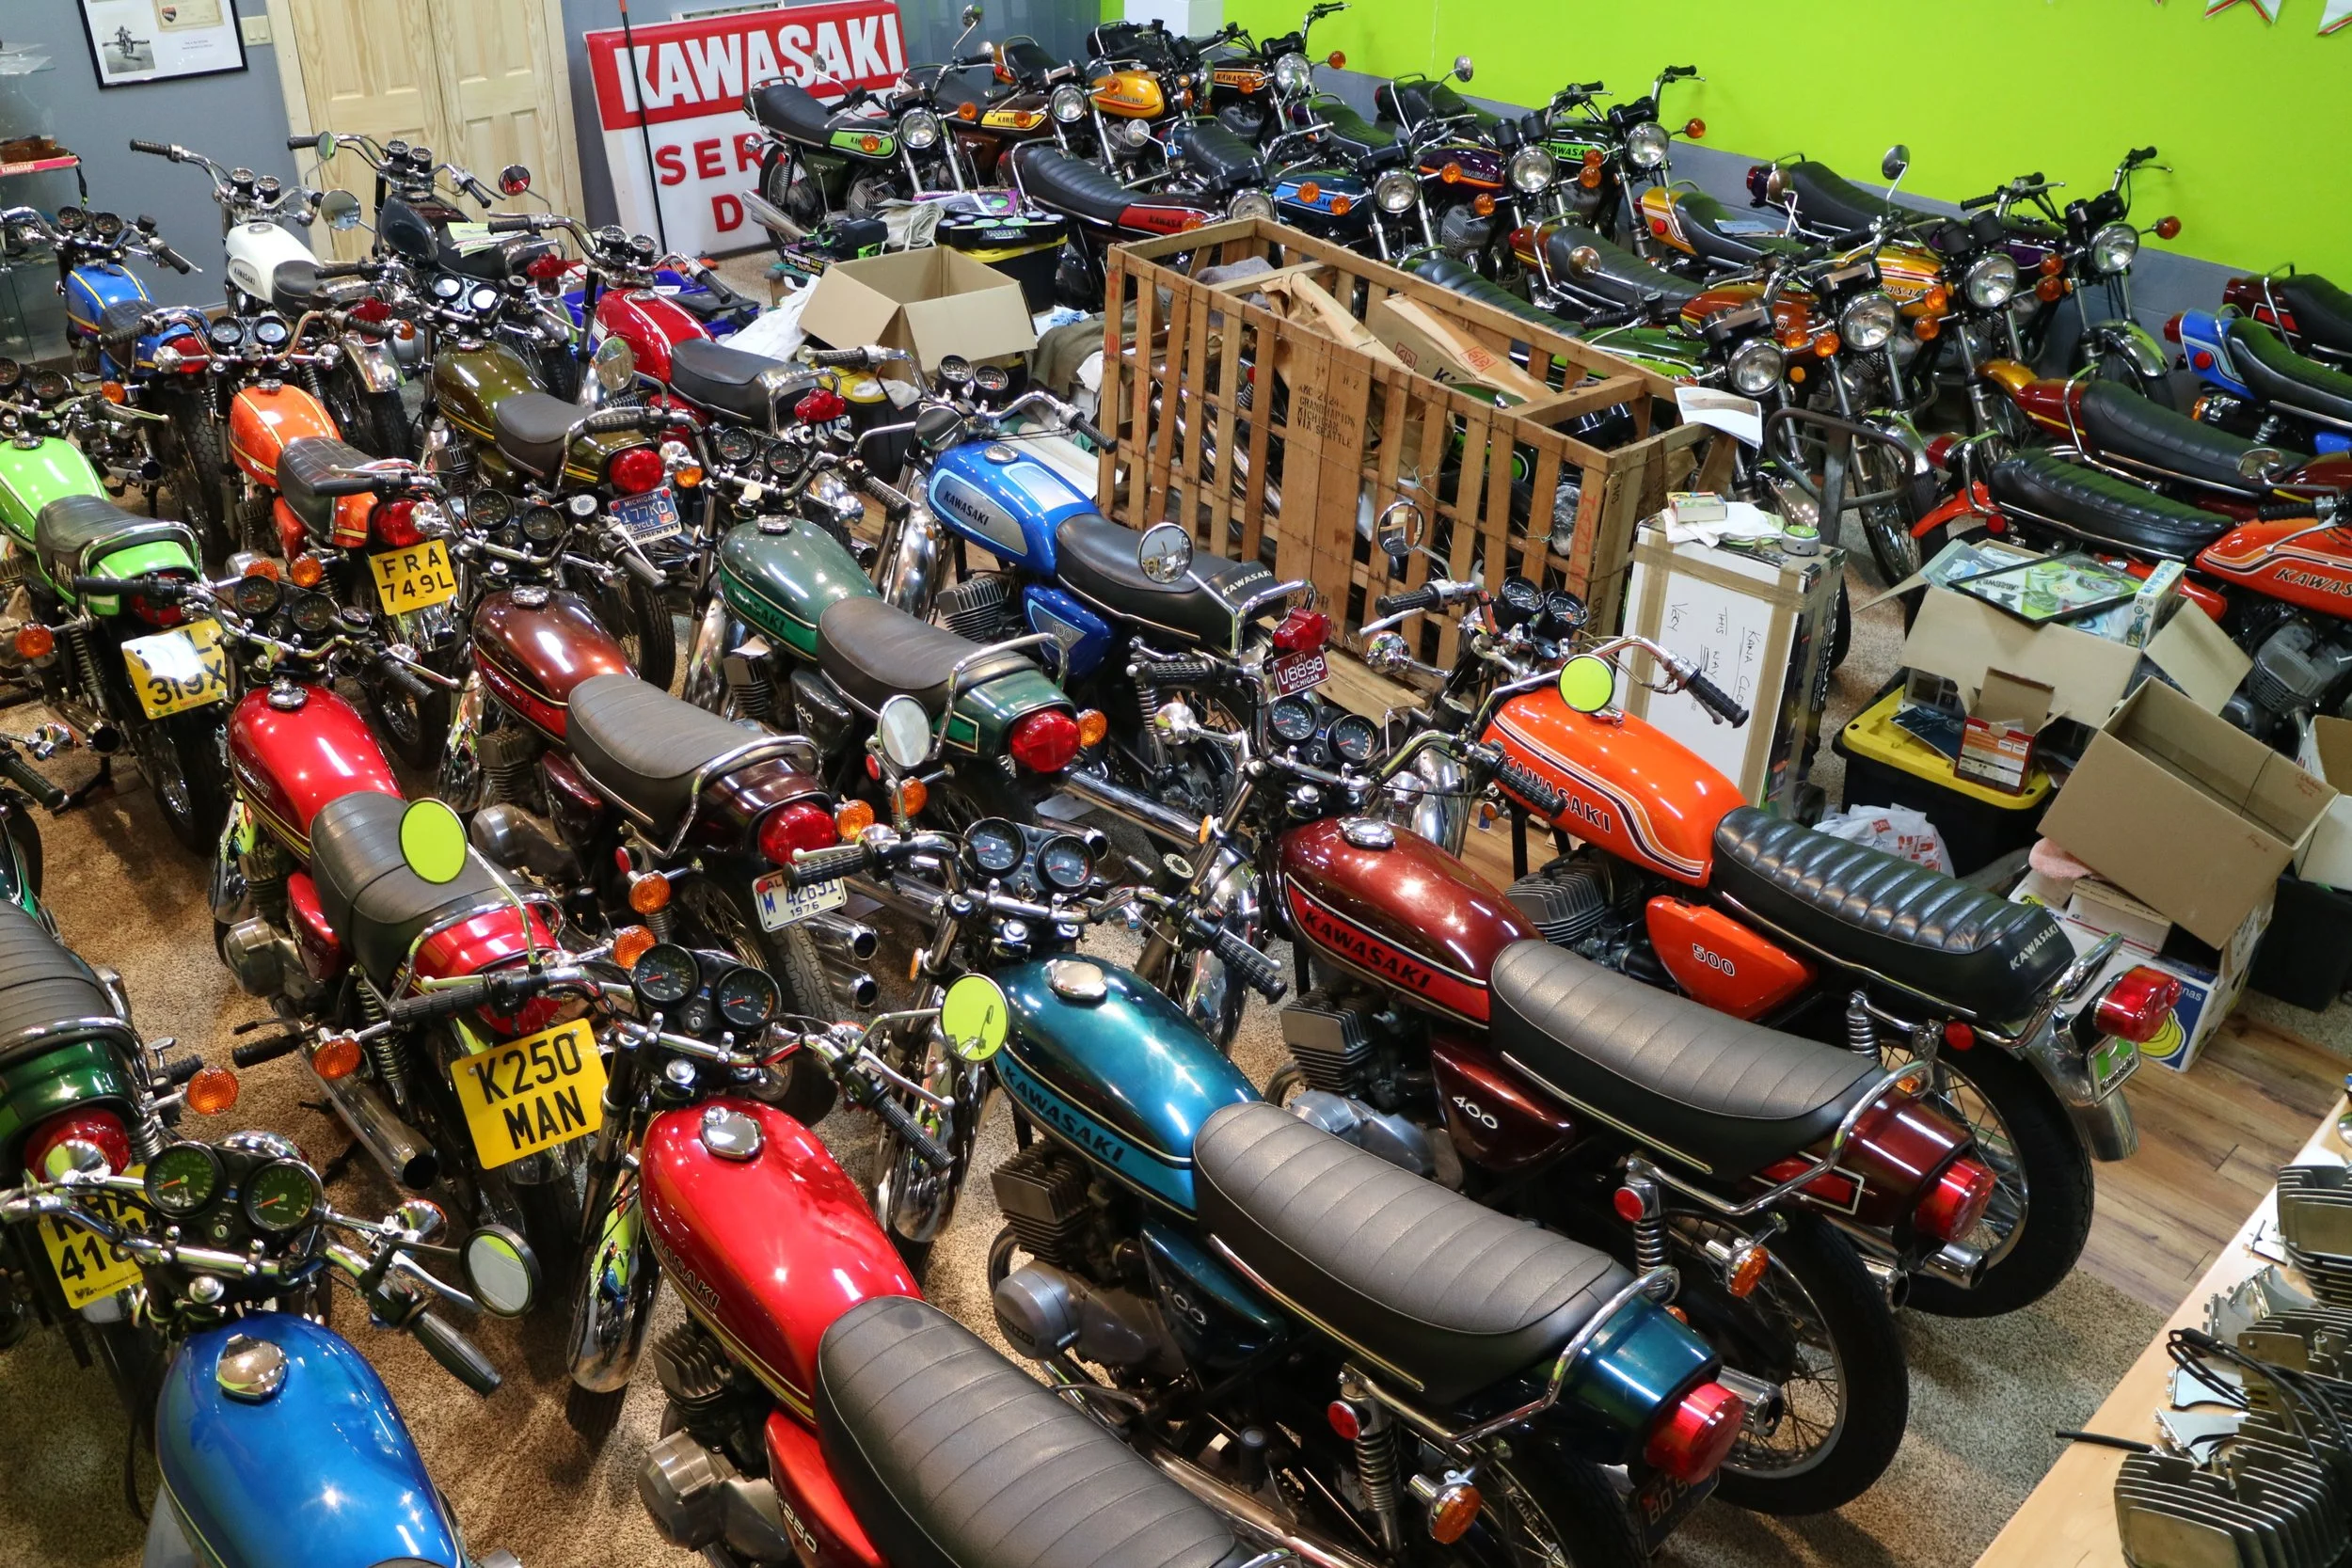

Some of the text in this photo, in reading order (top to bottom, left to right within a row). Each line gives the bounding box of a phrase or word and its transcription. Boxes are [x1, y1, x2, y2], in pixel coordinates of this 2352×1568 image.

[613, 12, 904, 113] KAWASAKI
[1148, 215, 1183, 229] KAWASA
[1296, 416, 1312, 433] VIA
[624, 493, 658, 508] MICHIGAN
[944, 490, 990, 527] KAWASAKI
[632, 518, 656, 532] CYCLE
[381, 548, 443, 579] FRA
[380, 571, 454, 604] 749L
[1221, 569, 1273, 597] KAWASAKI
[1665, 602, 1689, 632] VERY
[1270, 656, 1325, 686] V8898
[1291, 653, 1307, 665] 1971
[1281, 673, 1312, 691] MICHIGAN
[789, 900, 820, 918] 1976
[1303, 910, 1433, 990] KAWASAKI
[1692, 942, 1736, 976] 500
[2009, 922, 2060, 972] KAWASAKI
[474, 1033, 583, 1106] K250
[502, 1085, 588, 1150] MAN
[1004, 1064, 1126, 1164] KAWASAKI
[1451, 1094, 1499, 1131] 400
